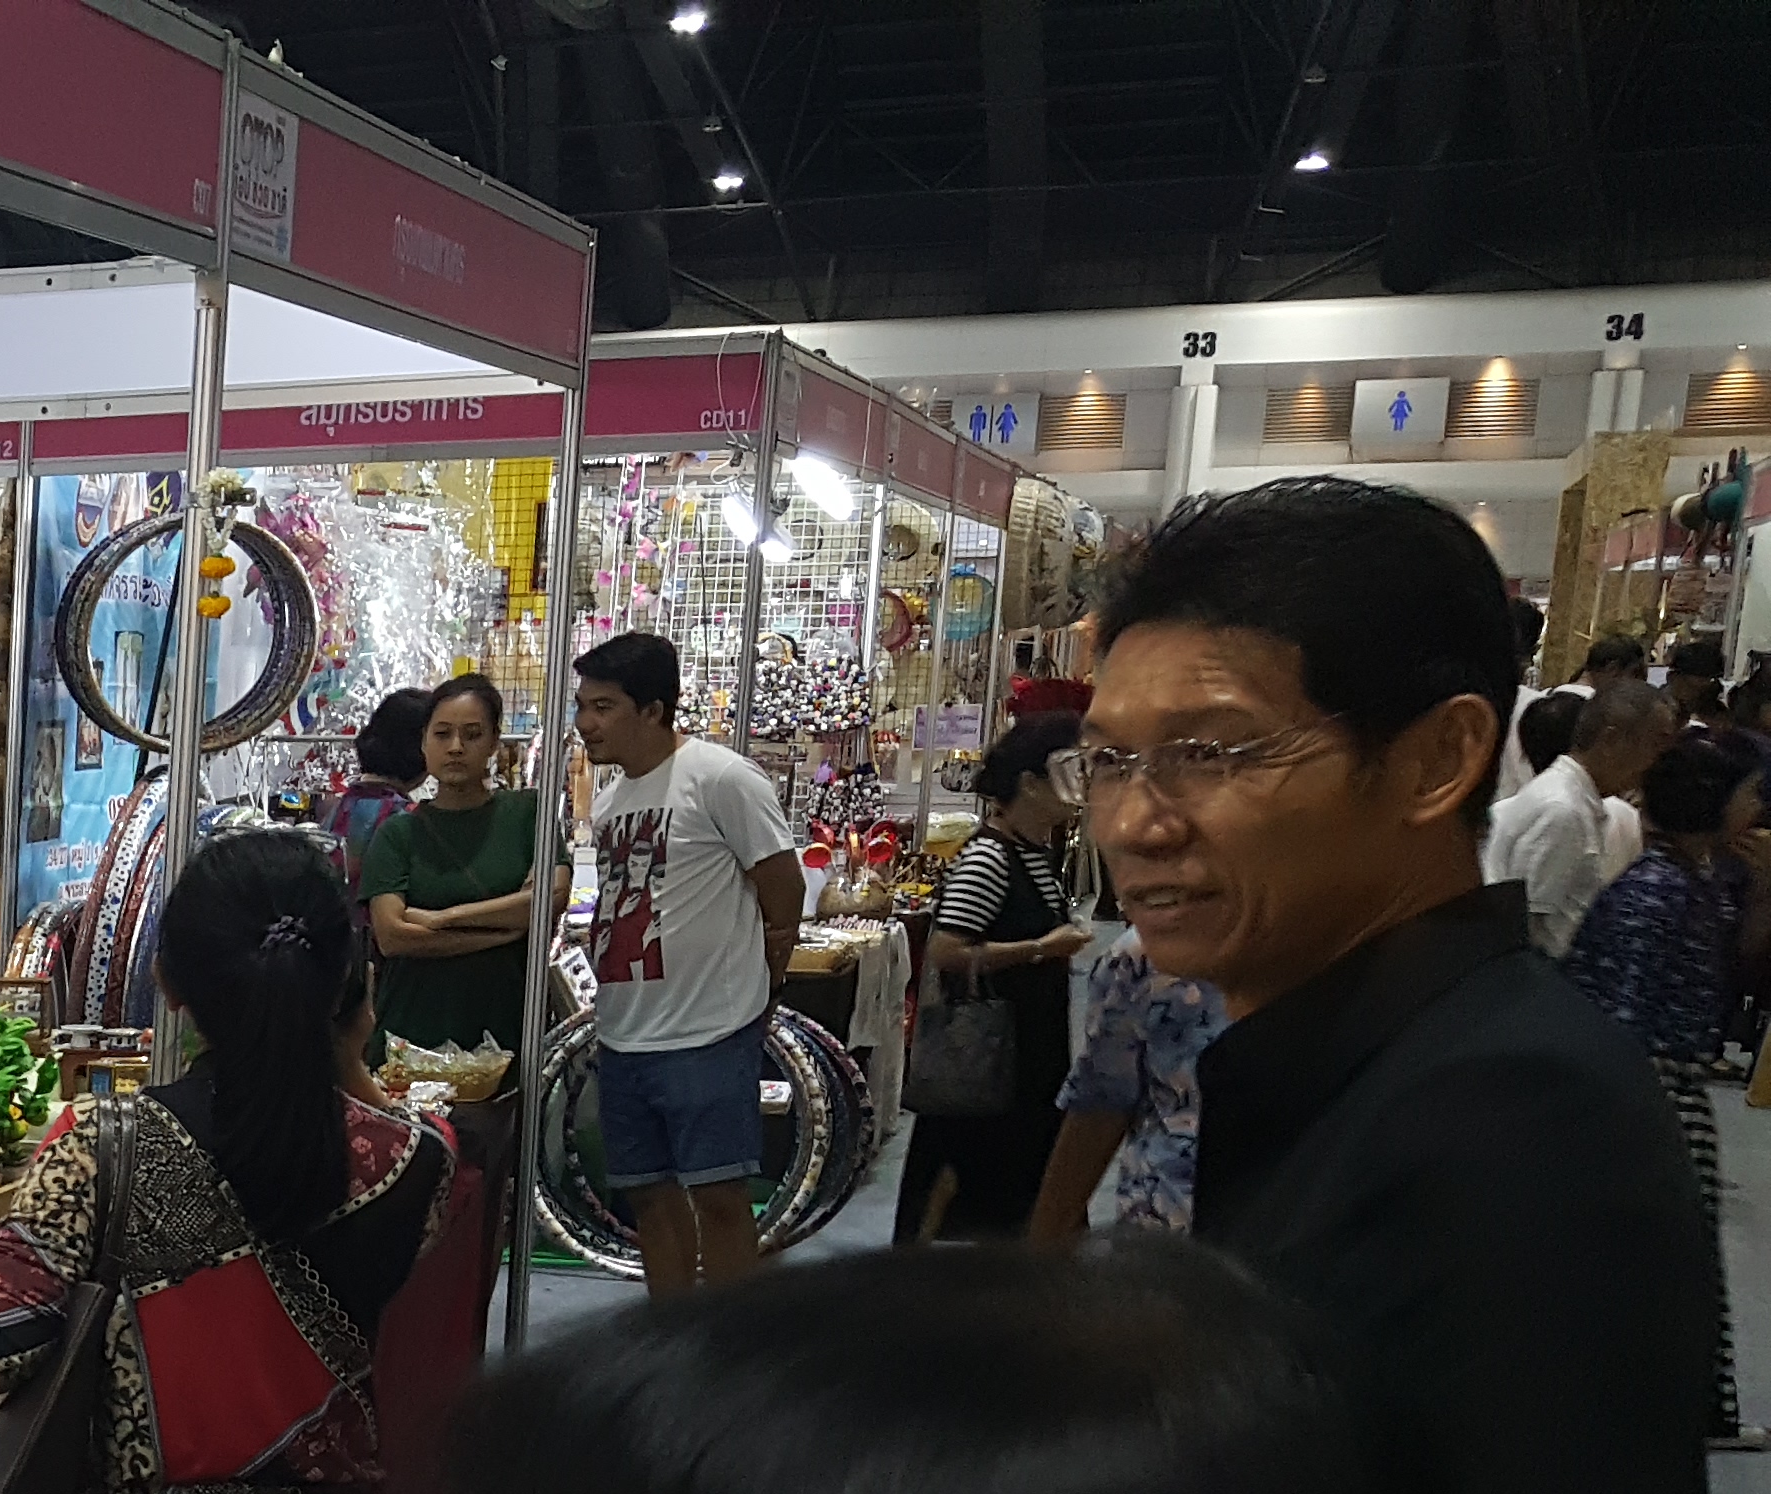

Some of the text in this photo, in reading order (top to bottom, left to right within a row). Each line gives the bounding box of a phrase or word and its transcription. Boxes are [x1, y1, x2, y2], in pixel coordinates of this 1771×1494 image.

[1605, 313, 1644, 341] 34
[1183, 332, 1217, 358] 33
[700, 409, 746, 430] CD11
